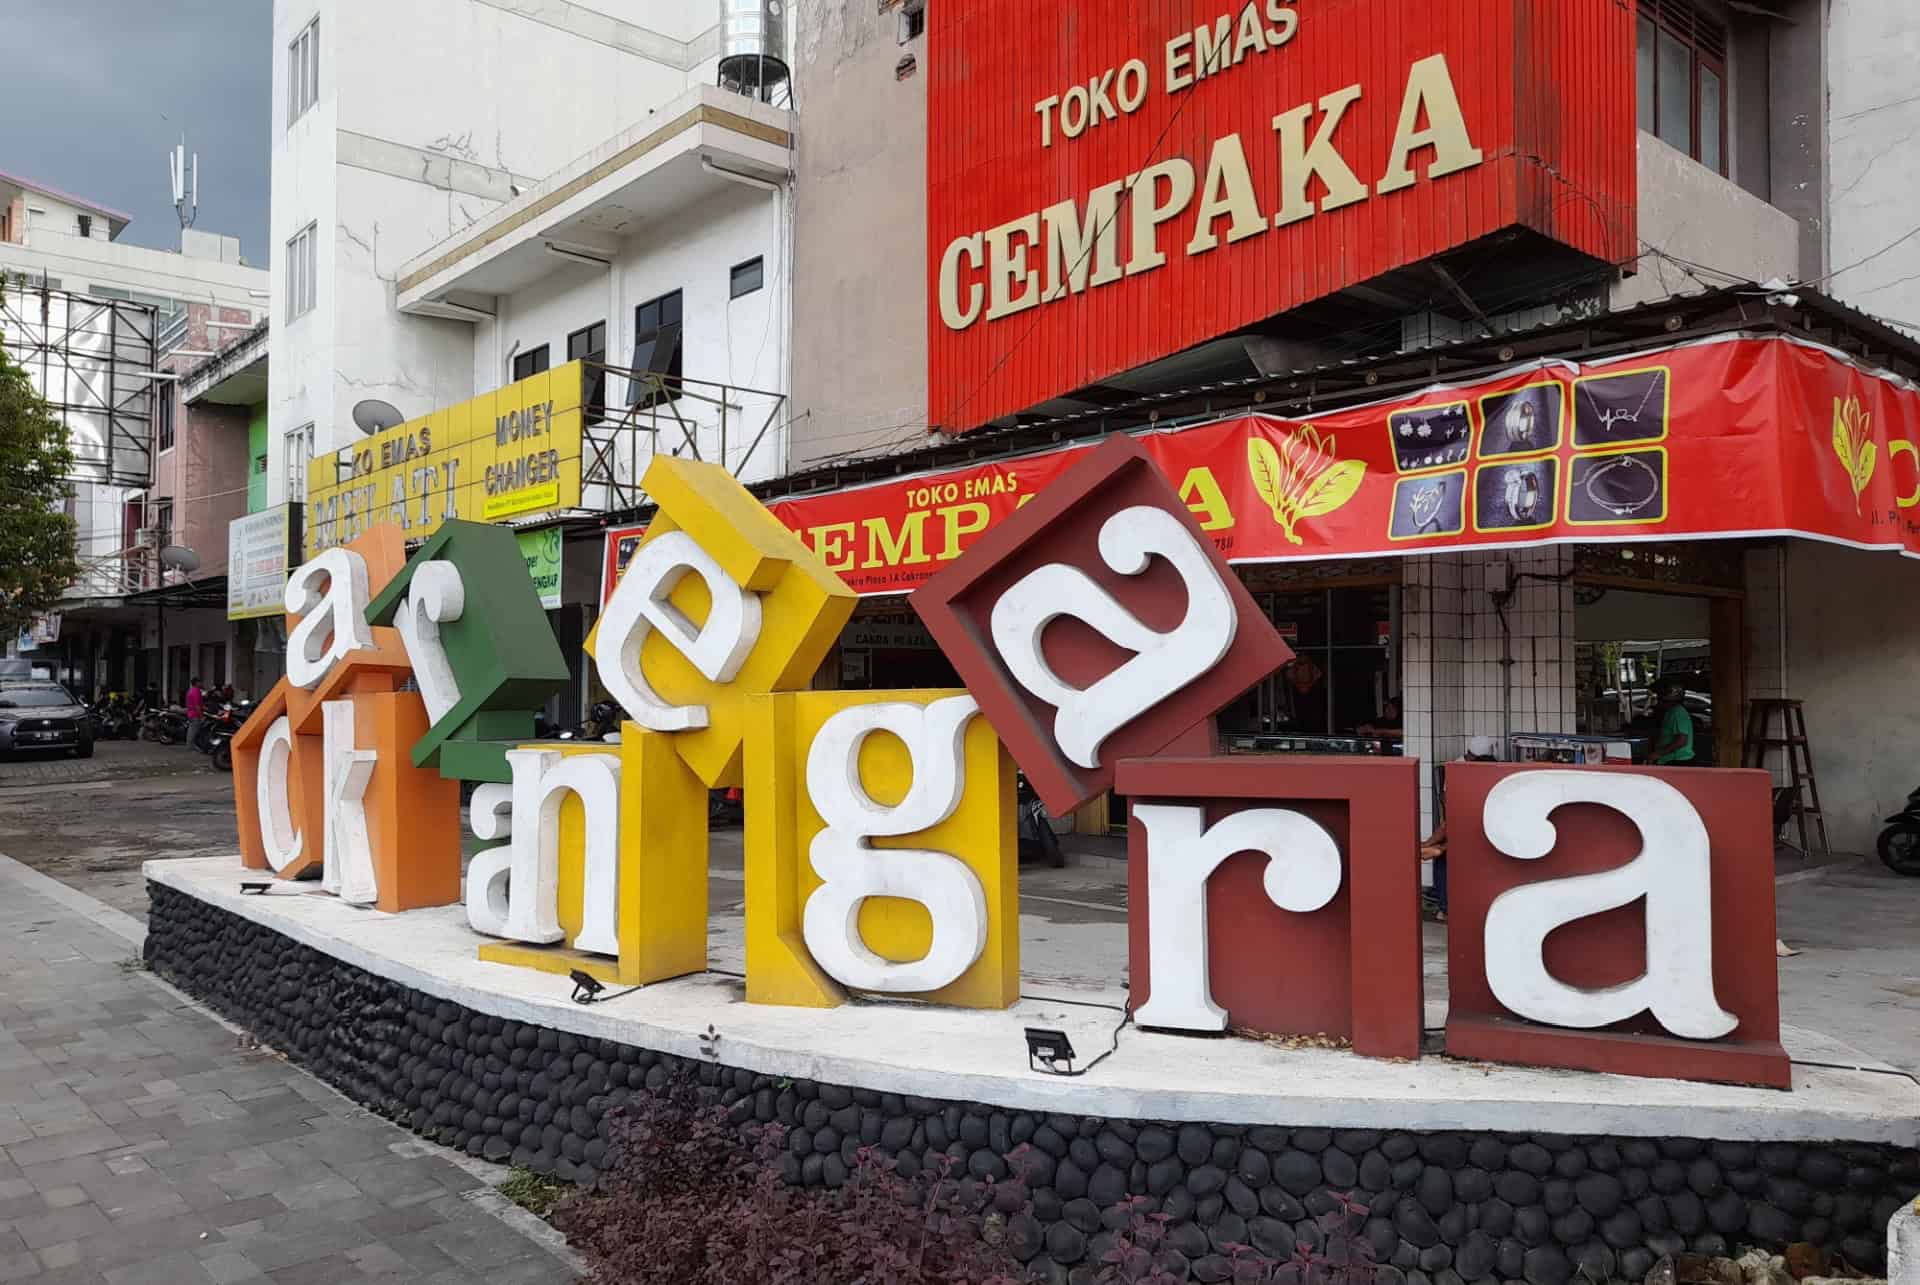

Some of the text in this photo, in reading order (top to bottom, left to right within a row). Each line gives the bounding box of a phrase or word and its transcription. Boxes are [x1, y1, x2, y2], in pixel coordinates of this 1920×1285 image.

[1035, 0, 1298, 146] TOKO EMAS
[938, 53, 1483, 330] CEMPAKA
[496, 400, 554, 448] MONEY
[382, 427, 431, 469] EMAS
[485, 449, 559, 495] CHANGER
[907, 471, 1018, 508] TOKO EMAS
